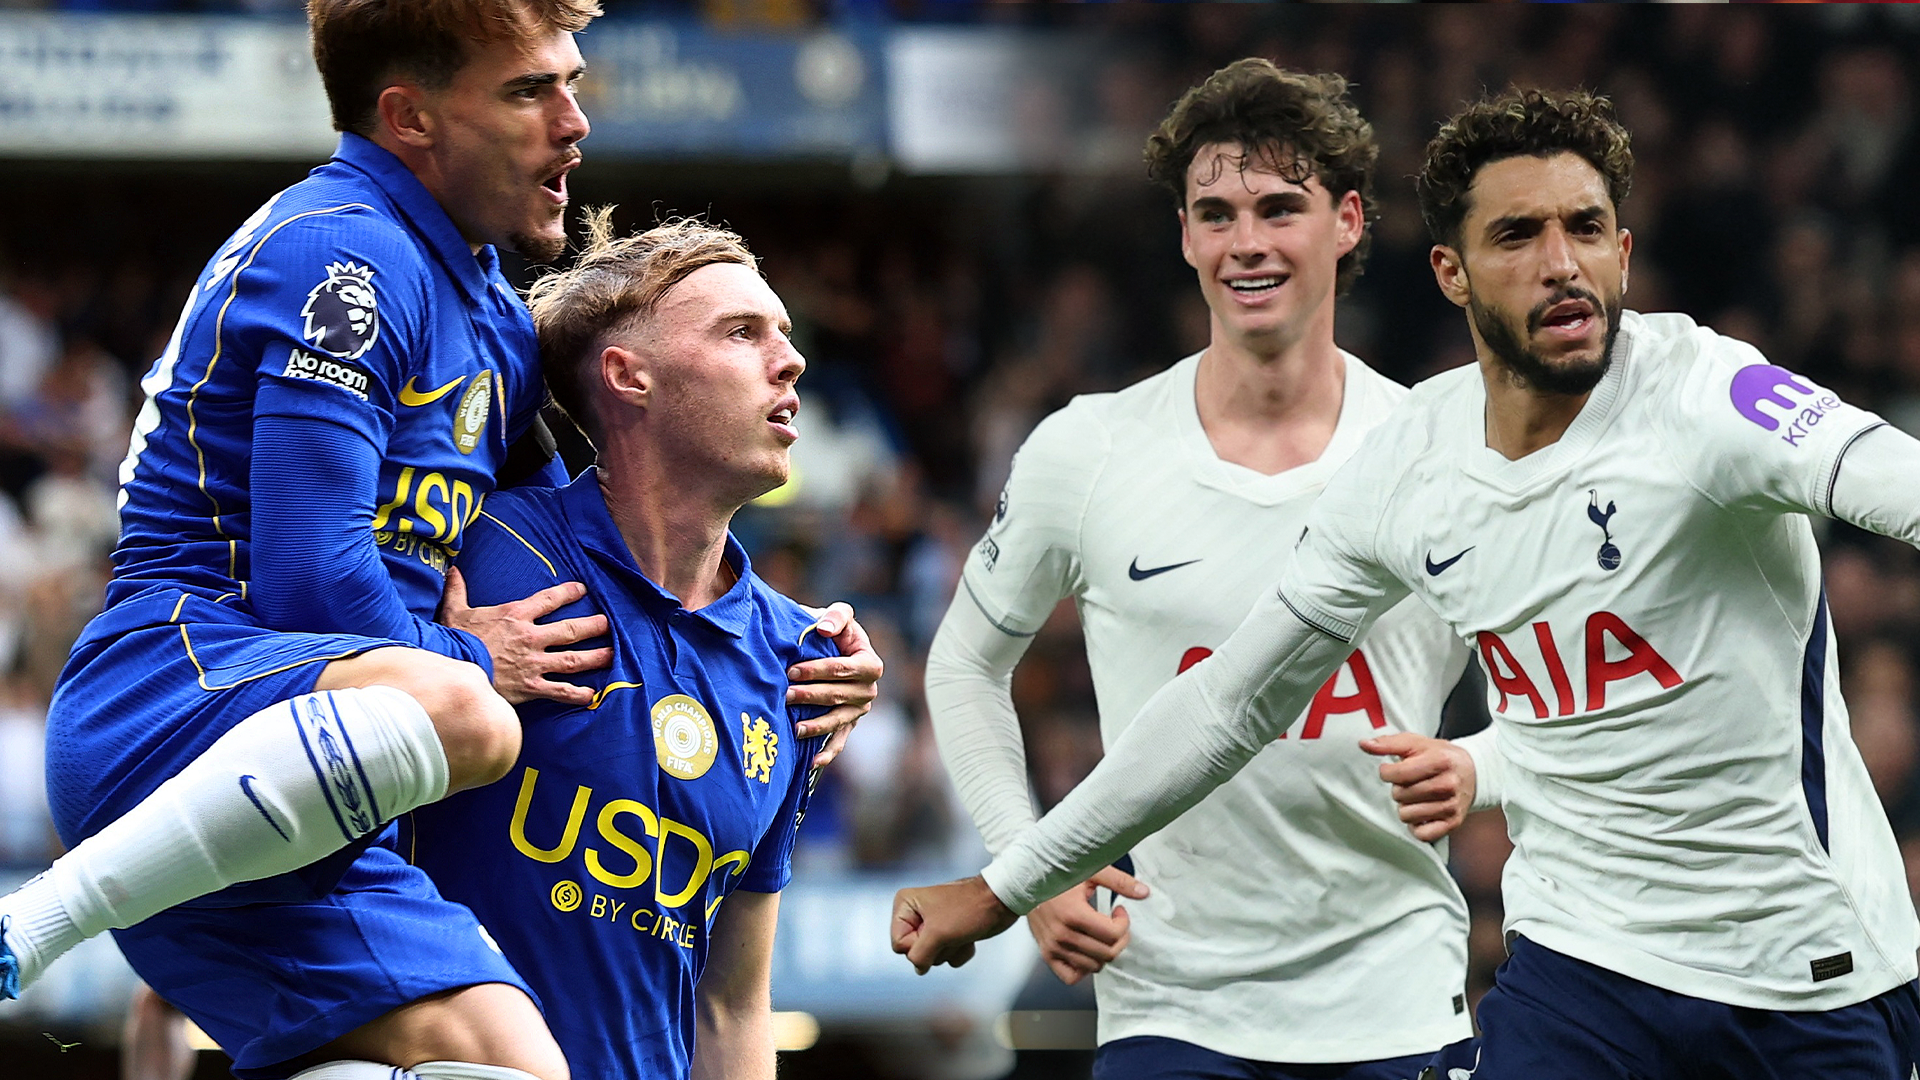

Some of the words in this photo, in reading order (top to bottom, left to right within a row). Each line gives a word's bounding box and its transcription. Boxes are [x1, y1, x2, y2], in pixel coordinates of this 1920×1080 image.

[287, 348, 319, 371] No
[317, 360, 368, 391] room
[1781, 396, 1841, 448] krake
[1476, 610, 1685, 720] AIA
[652, 704, 674, 739] WORLD
[674, 702, 713, 755] CHAMPIONS
[665, 755, 694, 774] FIFA
[590, 893, 626, 923] BY
[631, 908, 698, 949] CIRCLE
